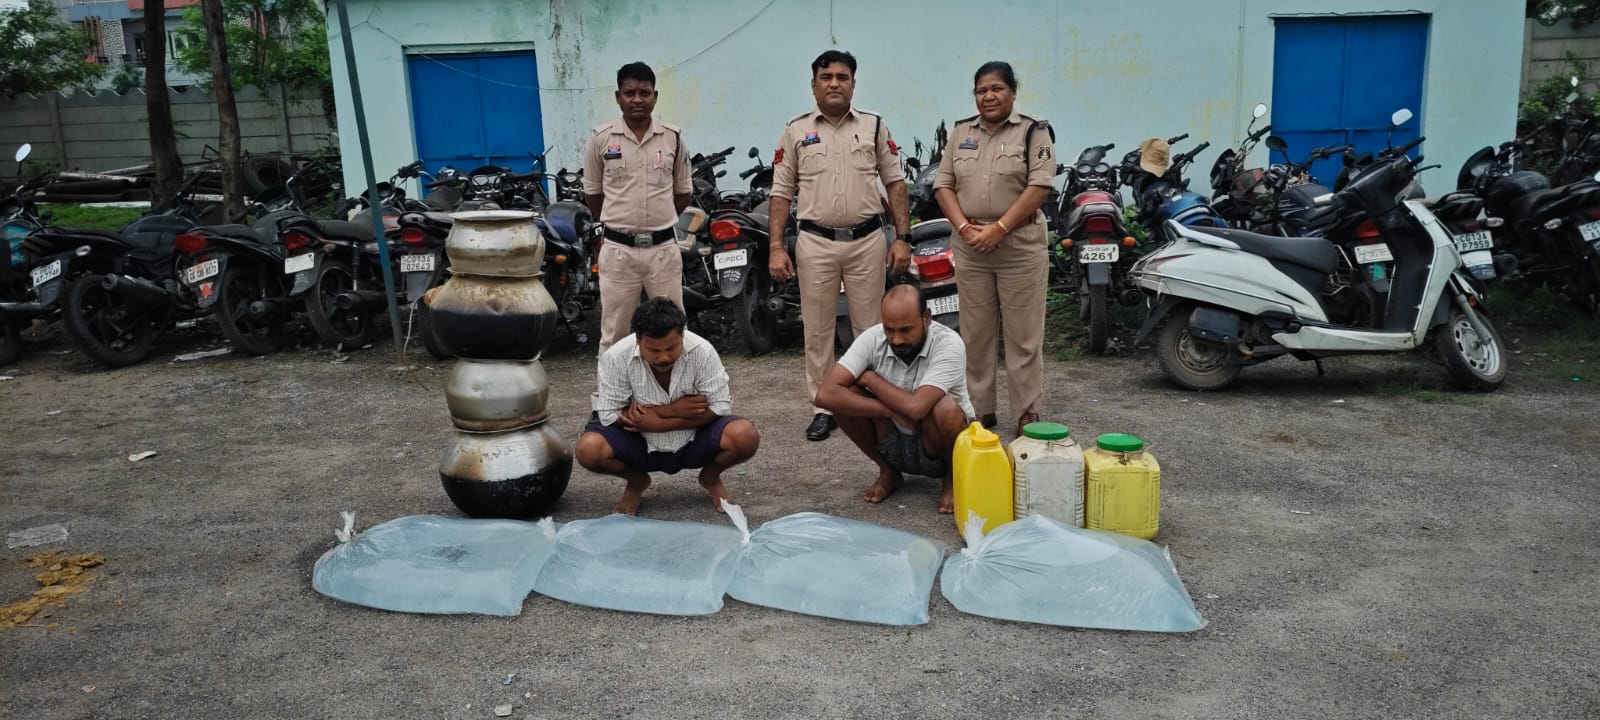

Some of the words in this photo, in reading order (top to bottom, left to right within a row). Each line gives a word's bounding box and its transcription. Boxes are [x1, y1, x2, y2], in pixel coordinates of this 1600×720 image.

[1460, 231, 1487, 242] CG13A
[1462, 240, 1490, 250] P7959
[1083, 252, 1113, 261] 4261
